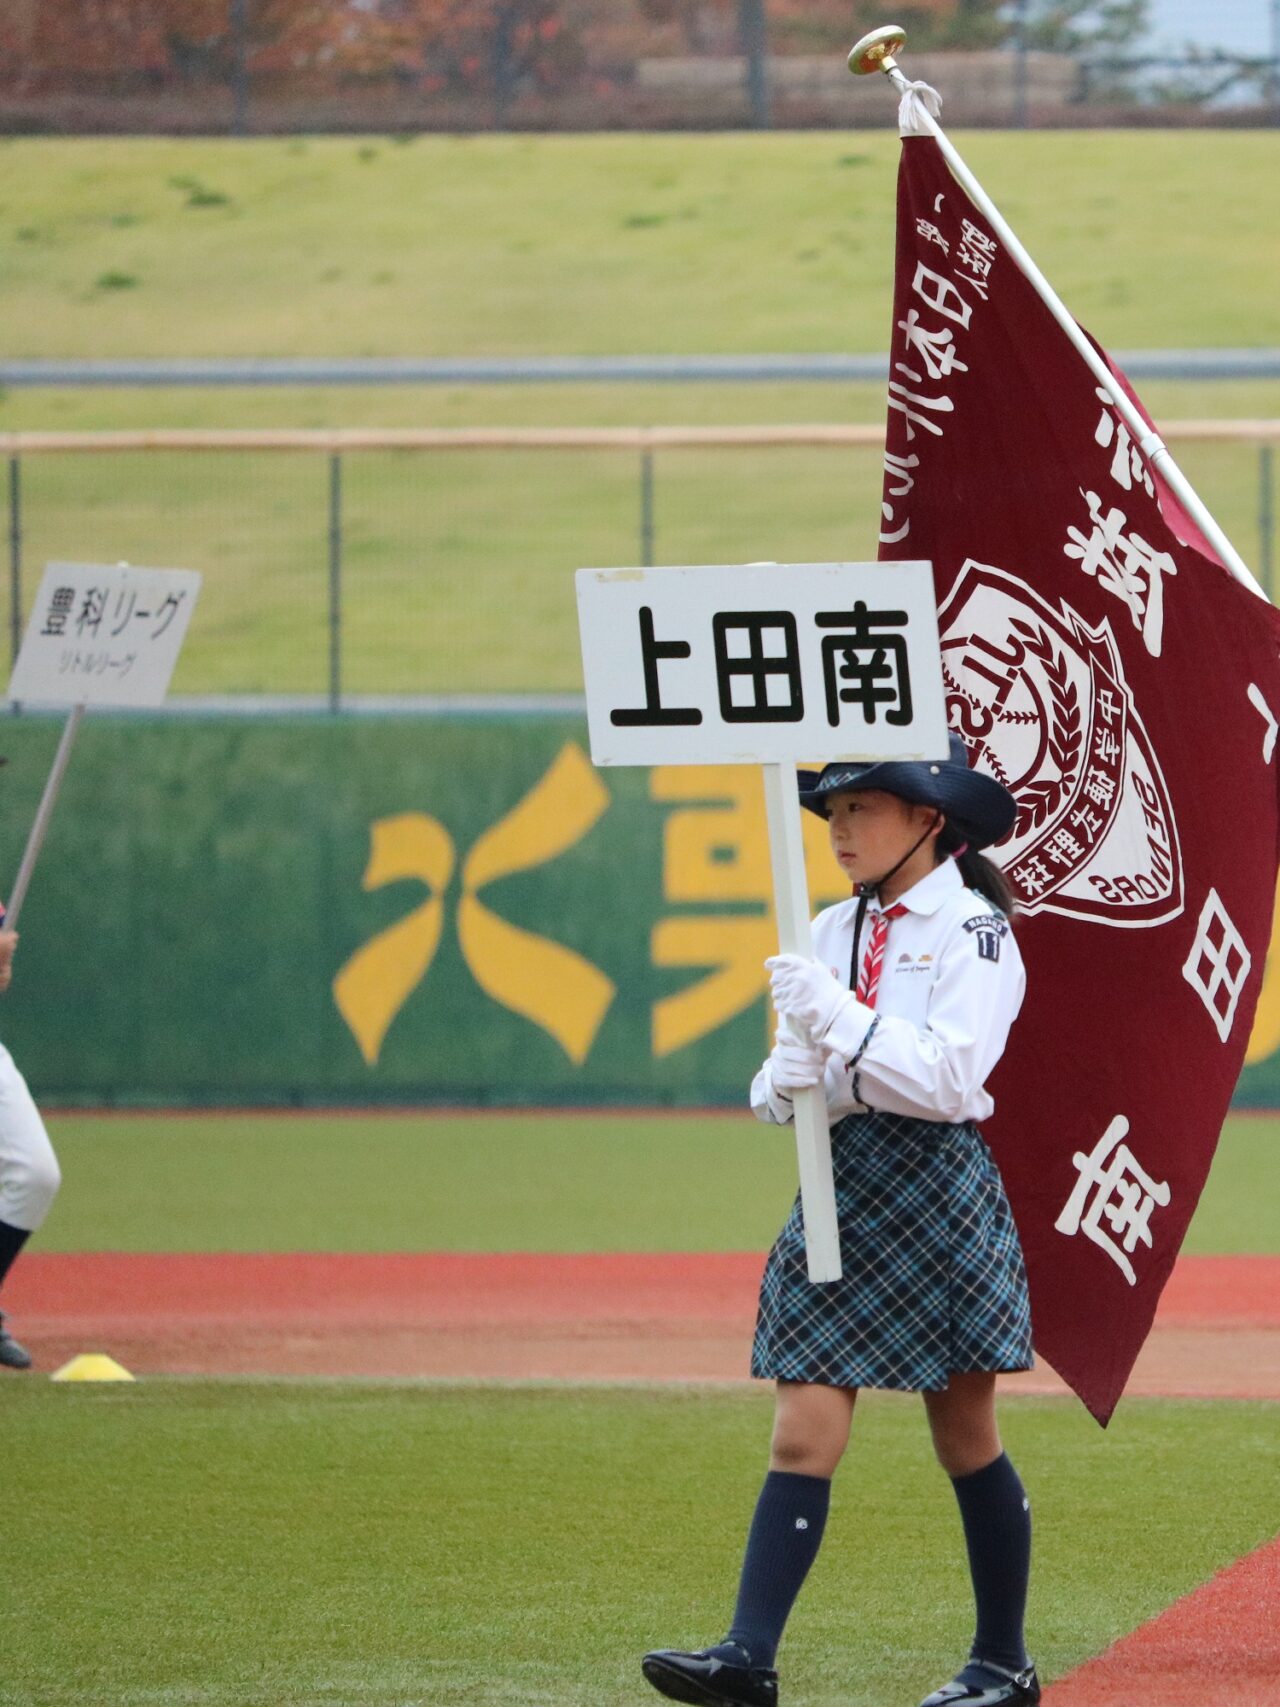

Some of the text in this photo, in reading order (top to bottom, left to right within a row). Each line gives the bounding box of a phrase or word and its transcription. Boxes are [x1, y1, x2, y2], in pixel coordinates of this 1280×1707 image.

[41, 586, 187, 640] 豊科リーグ
[610, 600, 914, 727] 上田南
[979, 931, 998, 961] 11
